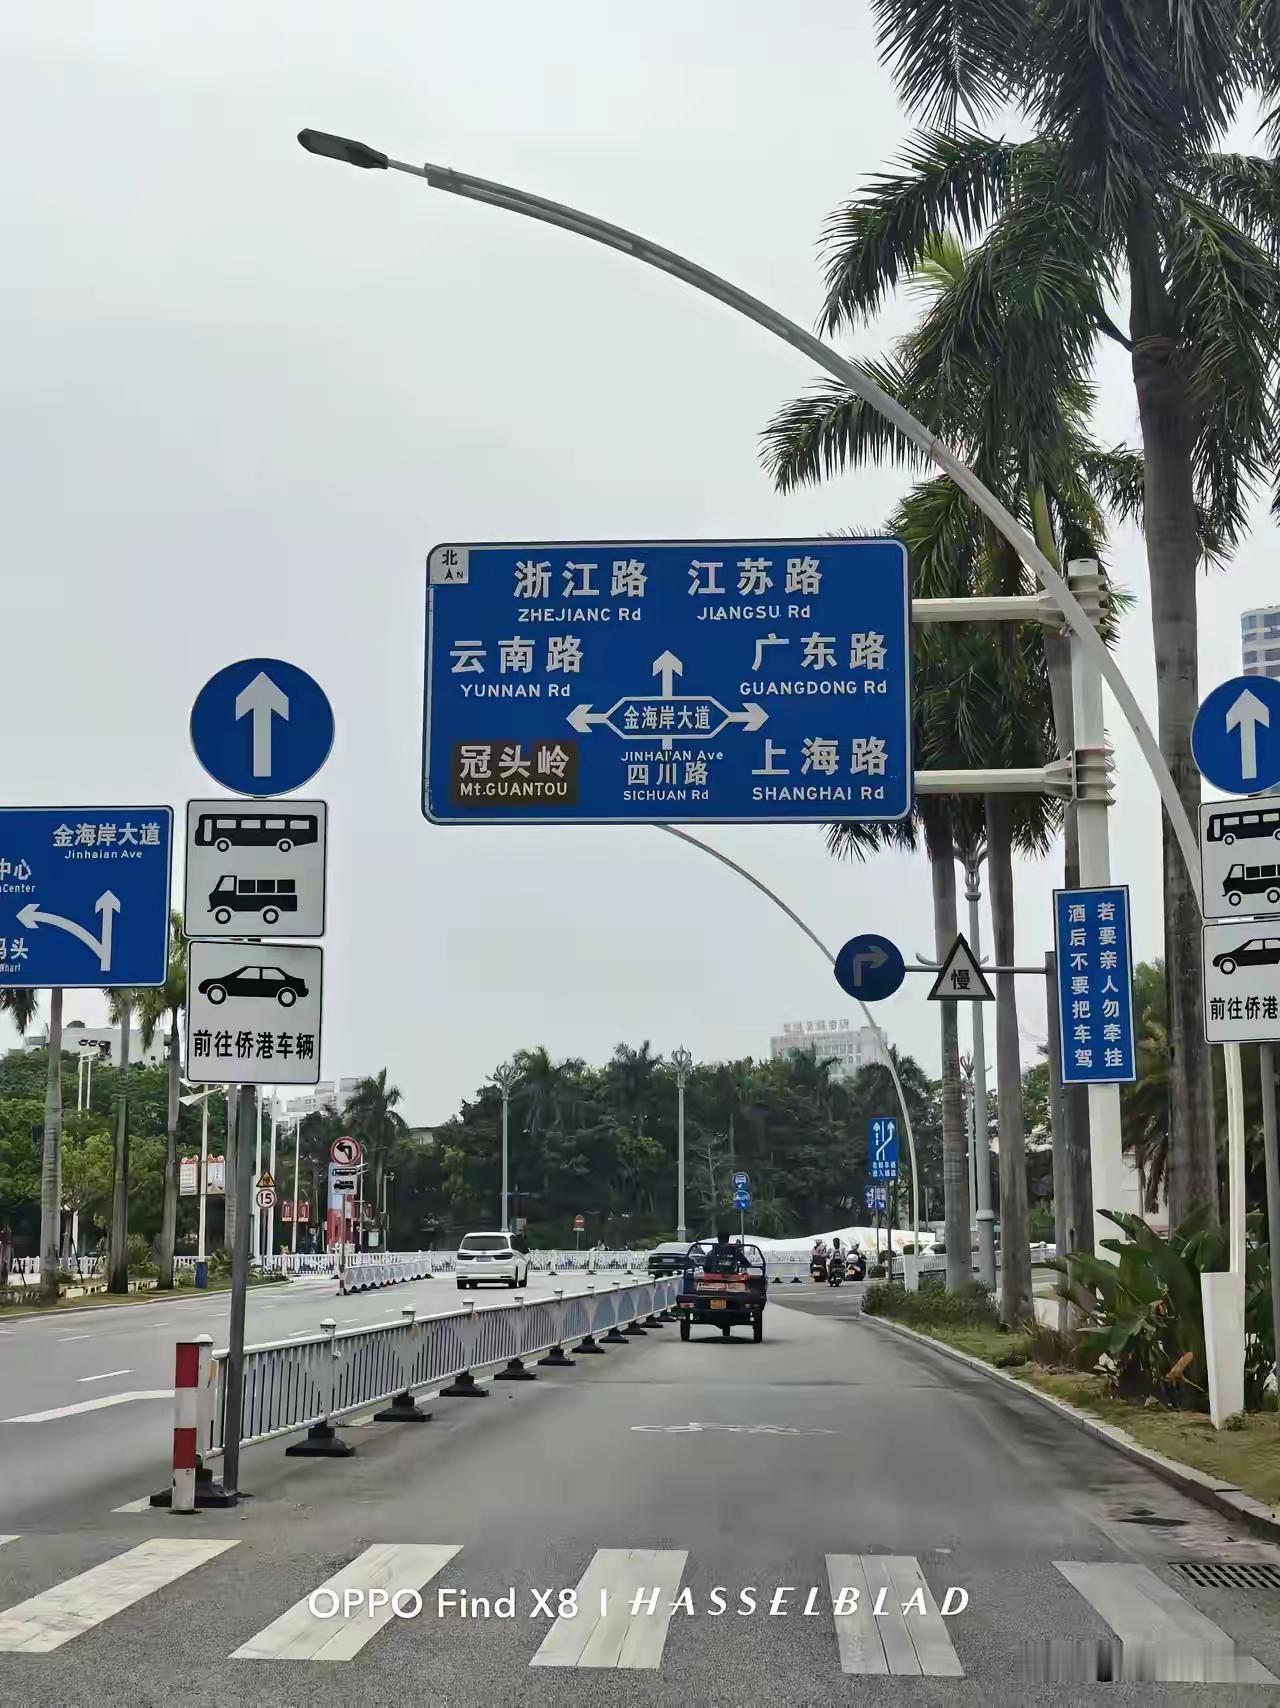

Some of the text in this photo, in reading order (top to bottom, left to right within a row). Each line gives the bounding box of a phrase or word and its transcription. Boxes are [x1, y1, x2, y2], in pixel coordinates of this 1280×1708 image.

[442, 550, 458, 566] 北
[513, 559, 648, 599] 浙江路
[687, 556, 823, 596] 江苏路
[618, 606, 642, 622] Rd
[697, 604, 812, 621] JIANGSU Rd
[450, 635, 584, 674] 云南路
[751, 631, 888, 671] 广东路
[460, 683, 571, 698] YUNNAN Rd
[740, 680, 887, 695] GUANGDONG Rd
[623, 704, 711, 730] 金海岸大道
[459, 744, 570, 779] 冠头岭
[621, 750, 724, 762] JINHAI'AN Ave
[751, 736, 889, 776] 上海路
[627, 760, 708, 786] 四川路
[460, 782, 568, 796] Mt.GUANTOU
[623, 789, 709, 801] SICHUAN Rd
[752, 786, 884, 801] SHANGHAI Rd
[52, 822, 161, 847] 金海岸大道
[120, 849, 143, 858] Ave
[0, 884, 36, 893] Center
[950, 968, 972, 990] 慢
[1068, 904, 1093, 1068] 酒后不要把车驾
[1097, 902, 1124, 1068] 若要亲人勿牵挂
[1209, 995, 1279, 1021] 前往侨港
[193, 1029, 315, 1060] 前往侨港车辆
[260, 1193, 273, 1205] 15
